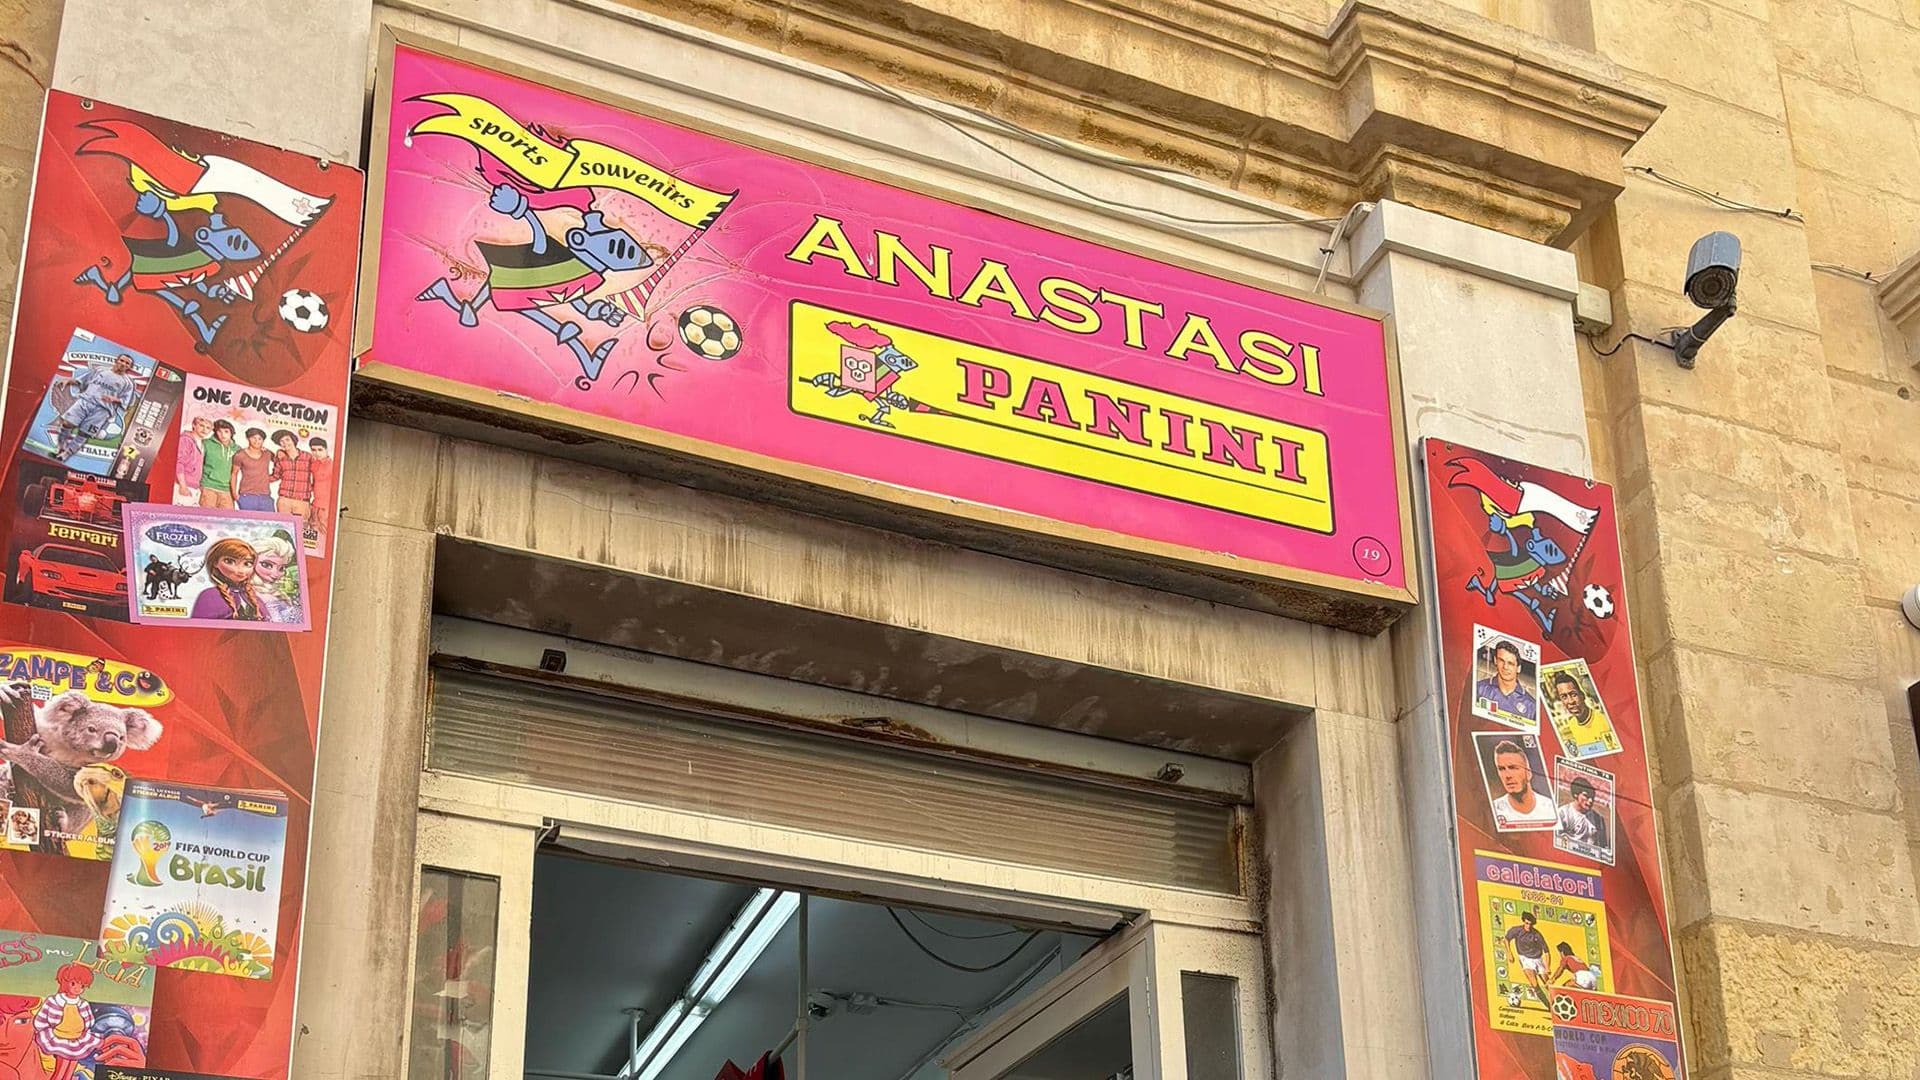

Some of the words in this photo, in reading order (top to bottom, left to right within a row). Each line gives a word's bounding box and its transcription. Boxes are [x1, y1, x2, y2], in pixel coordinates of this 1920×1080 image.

[469, 115, 548, 167] sports
[580, 160, 695, 209] souvenirs
[786, 214, 1325, 397] ANASTASI
[193, 386, 232, 405] ONE
[239, 392, 329, 425] DIRECTION
[956, 357, 1308, 485] PANINI
[128, 446, 135, 455] 7
[48, 522, 118, 548] Ferrari
[156, 531, 198, 543] FROZEN
[1362, 548, 1380, 560] 19
[155, 605, 185, 614] PANINI
[0, 653, 88, 690] ZAMPE
[249, 803, 276, 811] PANINI
[175, 842, 200, 853] FIFA
[202, 846, 246, 860] WORLD
[247, 853, 271, 863] CUP
[169, 854, 266, 893] Brasil
[1486, 863, 1595, 897] calciatori
[72, 940, 148, 989] LICIA
[1580, 998, 1650, 1032] MEXICO
[1650, 1007, 1674, 1035] 70
[1554, 1029, 1585, 1041] WORLD
[1590, 1032, 1606, 1044] CUP
